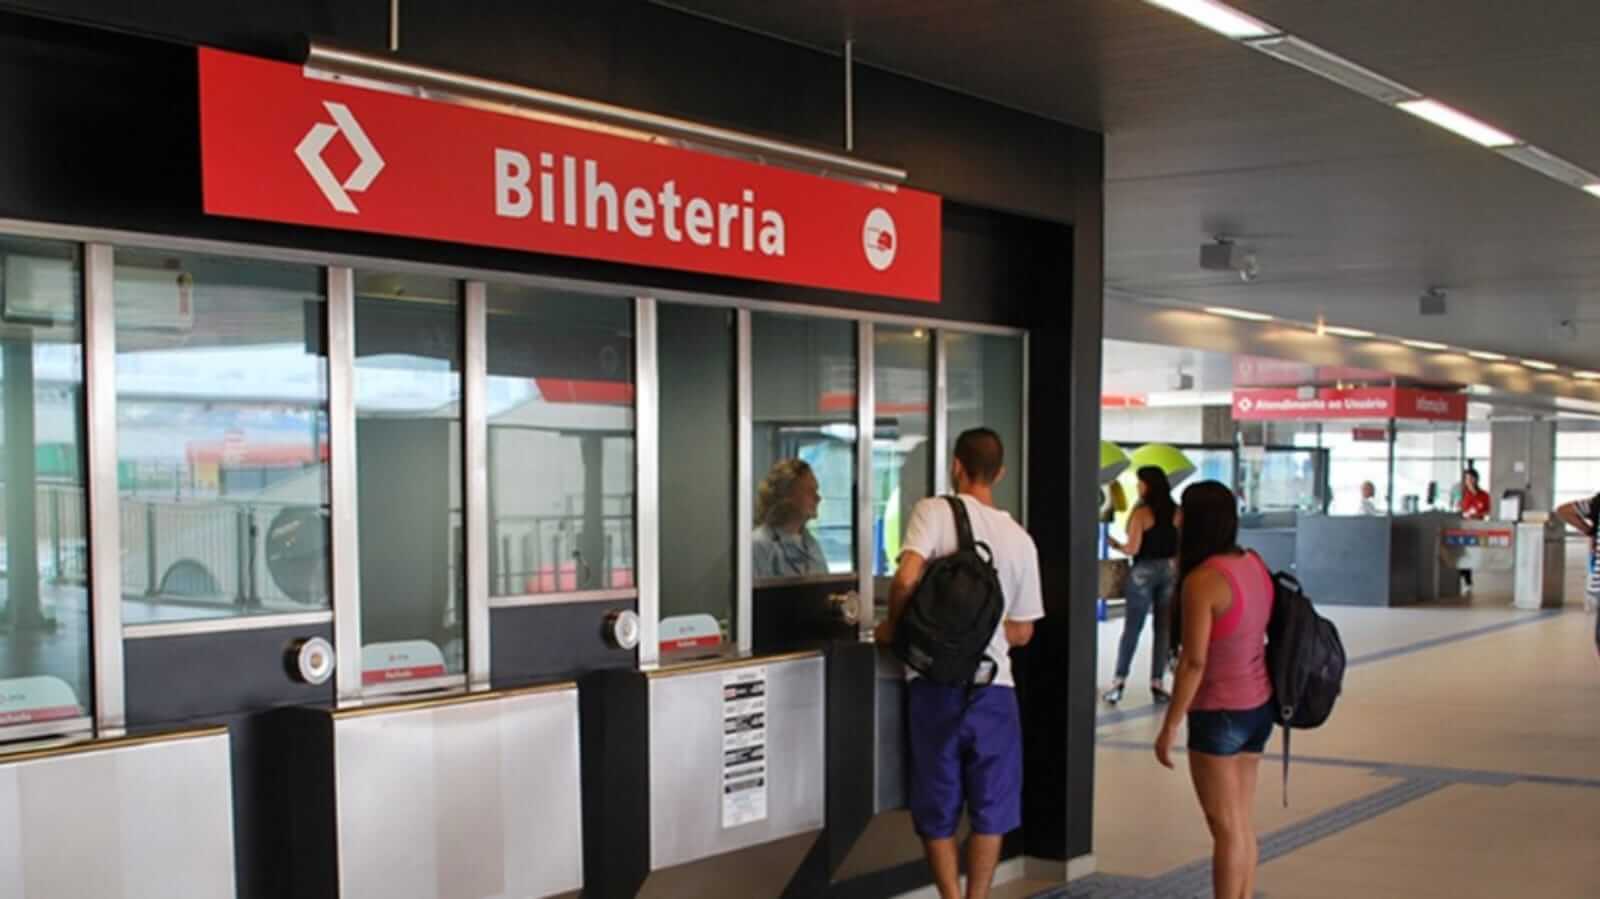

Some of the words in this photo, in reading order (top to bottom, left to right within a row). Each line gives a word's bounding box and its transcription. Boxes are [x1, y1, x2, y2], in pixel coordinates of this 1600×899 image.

[494, 147, 786, 256] Bilheteria
[1255, 398, 1326, 410] Atendimento
[1327, 400, 1343, 410] ao
[1344, 398, 1389, 410] Usuário
